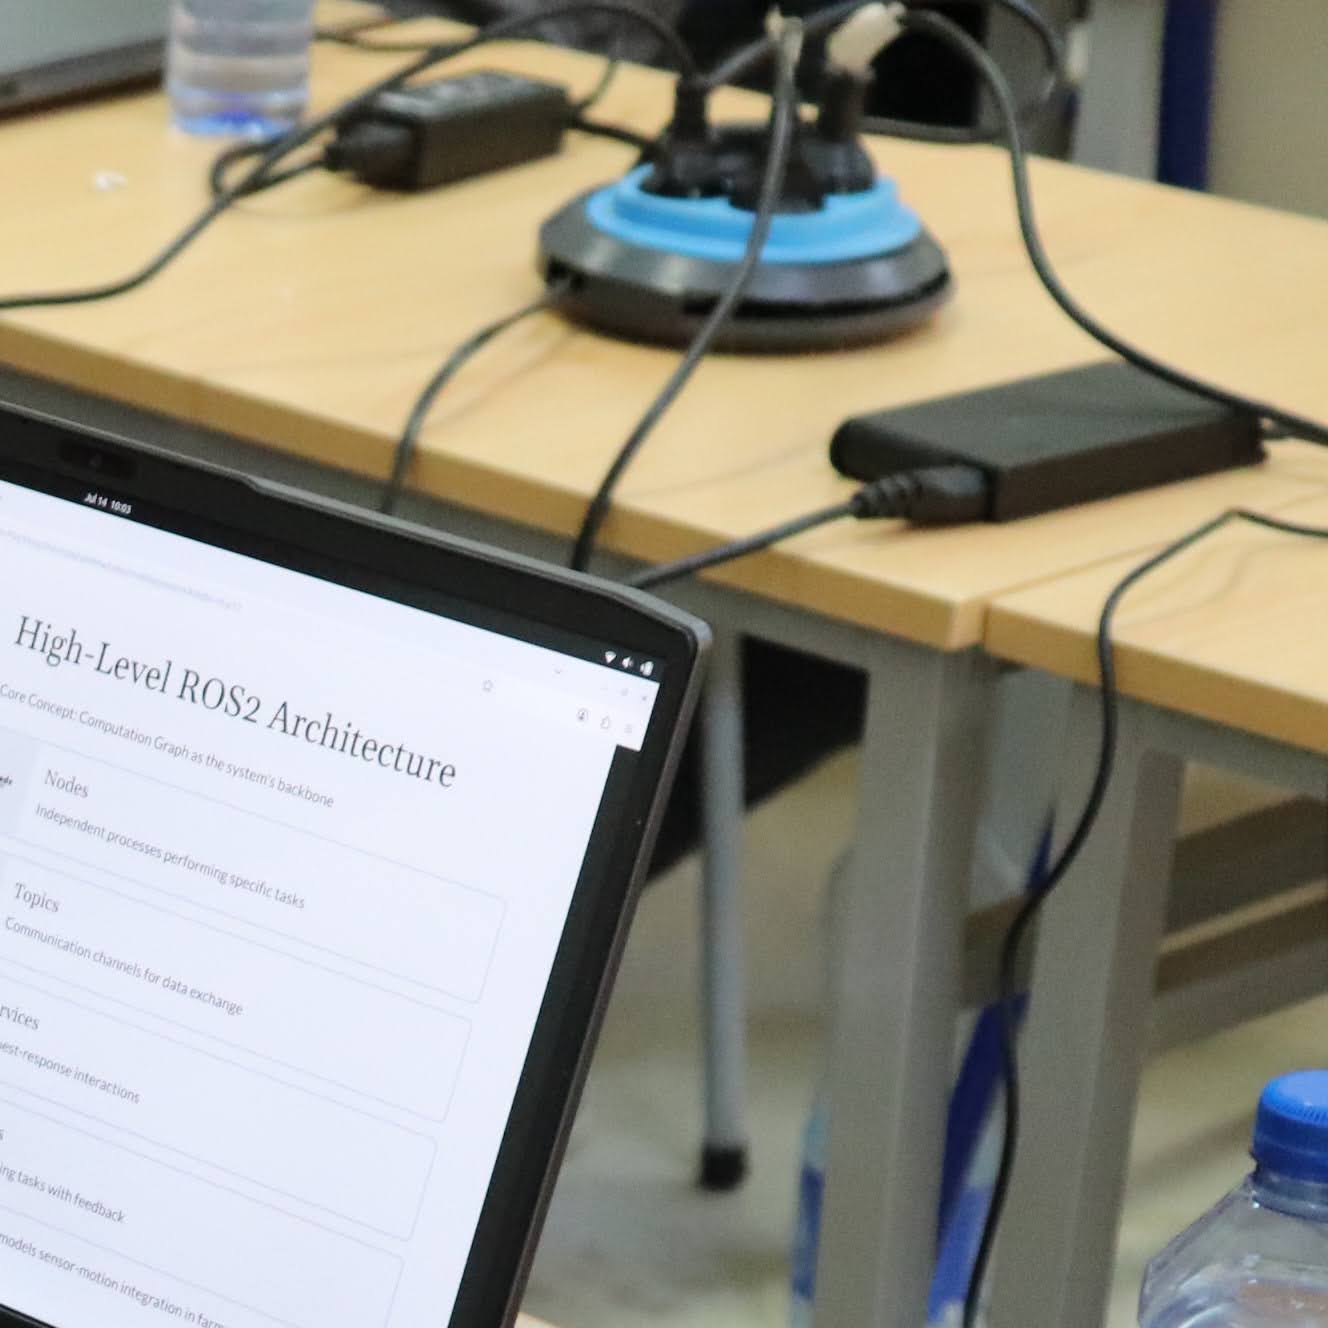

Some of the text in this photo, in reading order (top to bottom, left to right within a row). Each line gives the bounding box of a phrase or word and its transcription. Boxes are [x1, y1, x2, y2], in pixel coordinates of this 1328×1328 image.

[14, 614, 457, 788] High-Level ROS2 Architecture
[0, 683, 335, 808] Core Concept: Computation Graph as the system's backbone
[44, 767, 89, 799] Nodes
[35, 803, 306, 909] Independent processes performing specific tasks
[13, 881, 60, 914] Topics
[4, 915, 244, 1017] Communication channels for data exchange
[73, 1066, 141, 1105] interactions
[17, 1166, 46, 1192] tasks
[46, 1182, 74, 1206] with
[73, 1191, 127, 1225] feedback
[38, 1247, 119, 1292] sensor-motion
[119, 1279, 184, 1319] integration
[184, 1308, 197, 1324] in
